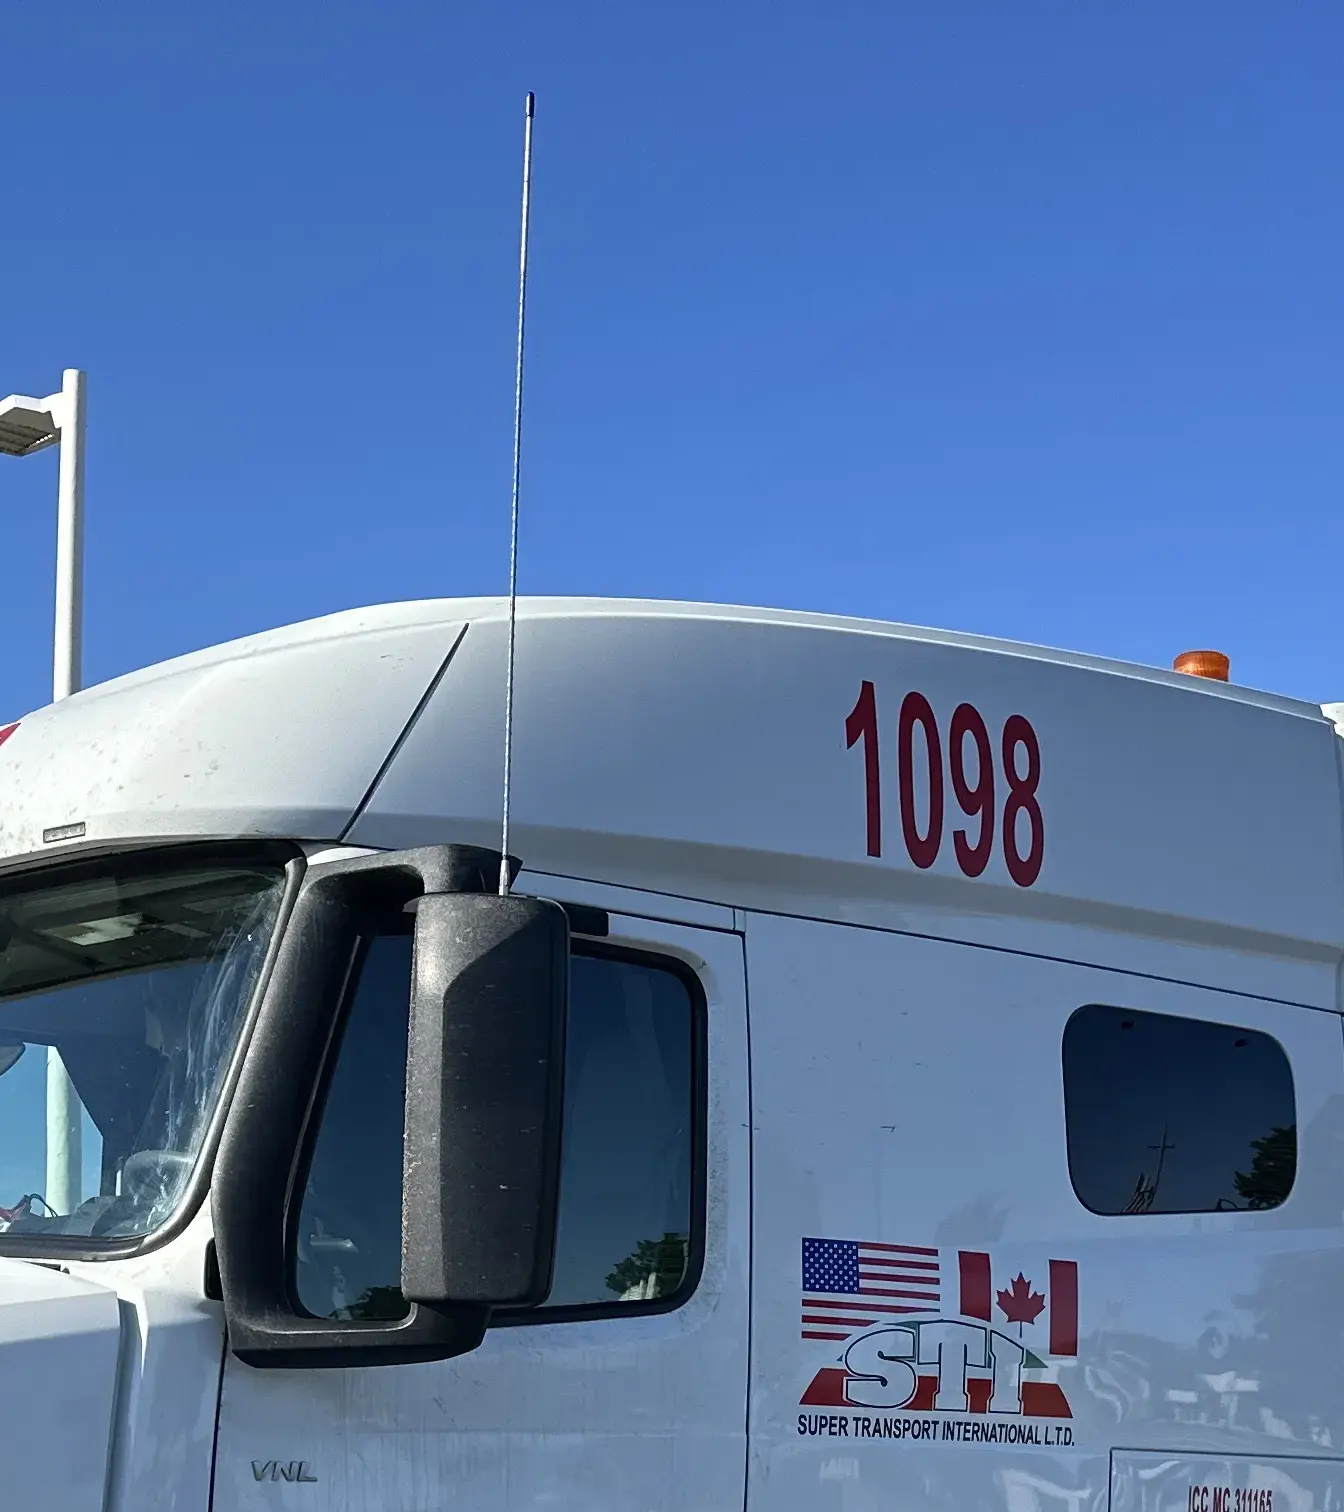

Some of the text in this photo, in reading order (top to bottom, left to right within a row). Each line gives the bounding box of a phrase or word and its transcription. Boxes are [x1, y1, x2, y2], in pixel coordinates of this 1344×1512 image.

[845, 680, 1044, 888] 1098
[844, 1319, 1024, 1415] STI
[797, 1414, 1075, 1447] SUPER TRANSPORT INTERNATIONAL L.T.D.
[250, 1460, 318, 1483] VNL
